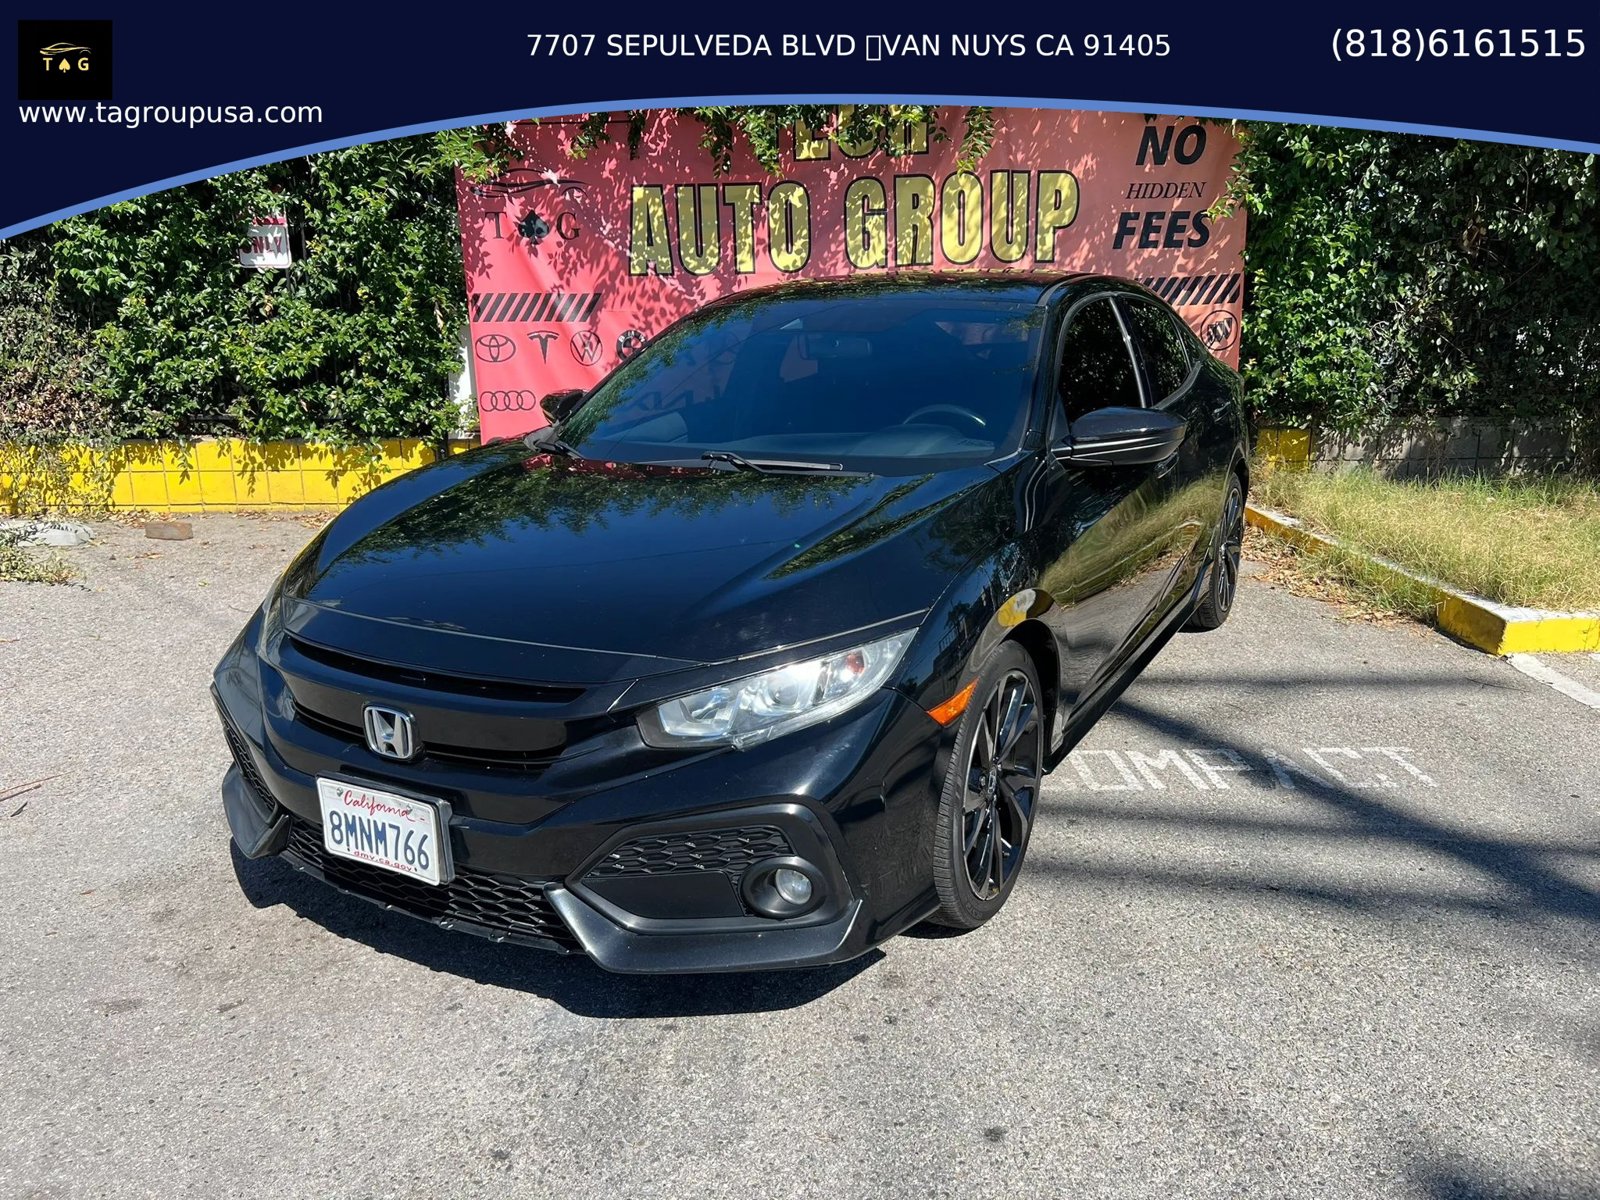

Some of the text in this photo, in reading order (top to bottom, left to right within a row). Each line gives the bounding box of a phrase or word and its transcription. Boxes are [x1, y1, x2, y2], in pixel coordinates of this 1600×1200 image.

[1135, 124, 1207, 166] NO
[1125, 181, 1208, 199] HIDDEN
[629, 169, 1080, 277] AUTO GROUP
[1112, 210, 1211, 250] FEES
[1060, 746, 1438, 792] OMPACT
[343, 789, 417, 823] California
[329, 809, 430, 871] 8MNM766
[353, 850, 413, 873] dmv.ca.gov
